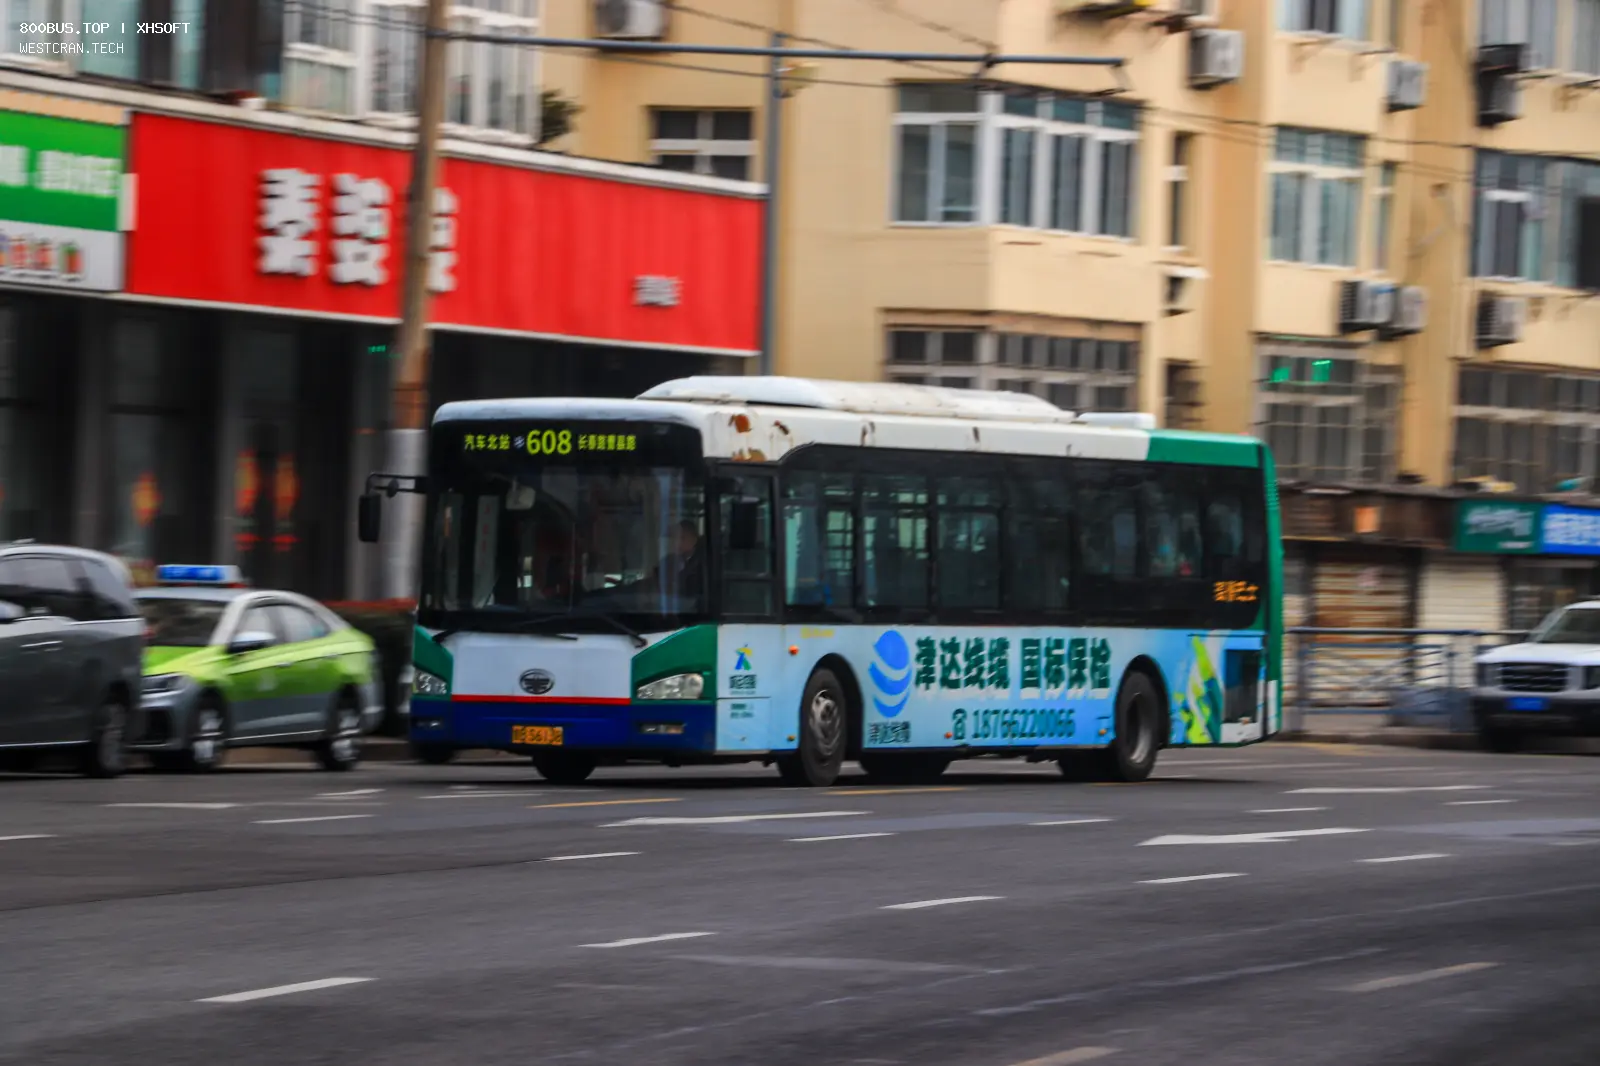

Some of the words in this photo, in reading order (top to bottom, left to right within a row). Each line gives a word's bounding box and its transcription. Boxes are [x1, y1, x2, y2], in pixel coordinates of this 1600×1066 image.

[464, 434, 511, 451] 汽车北站
[526, 429, 572, 455] 608
[914, 635, 1010, 690] 津达线缆
